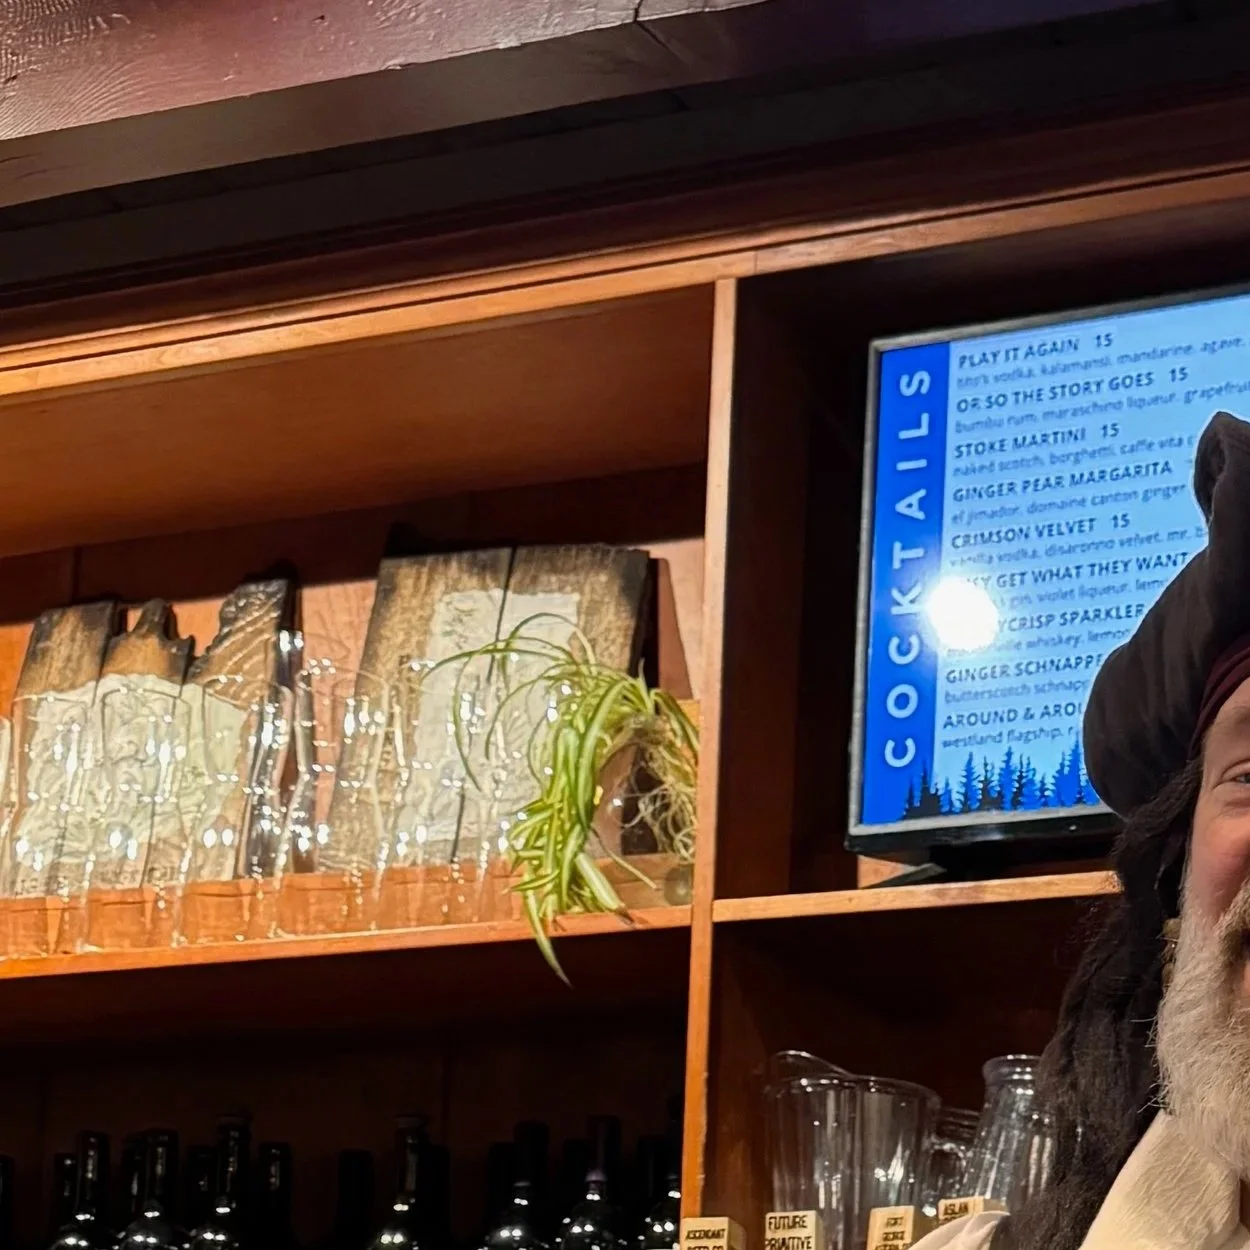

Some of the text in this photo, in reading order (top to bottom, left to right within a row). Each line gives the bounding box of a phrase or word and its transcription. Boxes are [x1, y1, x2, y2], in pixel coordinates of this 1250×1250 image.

[958, 332, 1113, 369] PLAY IT AGAIN 15
[956, 365, 1188, 413] OR SO THE STORY GOES 15
[954, 422, 1120, 459] STOKE MARTINI 15
[952, 479, 1017, 503] GINGER
[1021, 473, 1065, 494] PEAR
[1068, 458, 1172, 487] MARGARITA
[950, 511, 1131, 550] CRIMSON VELVET 15
[884, 370, 932, 767] COCKTAILS
[996, 569, 1028, 589] GET
[1030, 562, 1084, 585] WHAT
[1085, 556, 1132, 578] THEY
[1134, 549, 1189, 571] WANT
[945, 662, 1011, 685] GINGER
[942, 706, 1018, 731] AROUND
[1022, 706, 1035, 720] &
[768, 1215, 808, 1230] FUTURE
